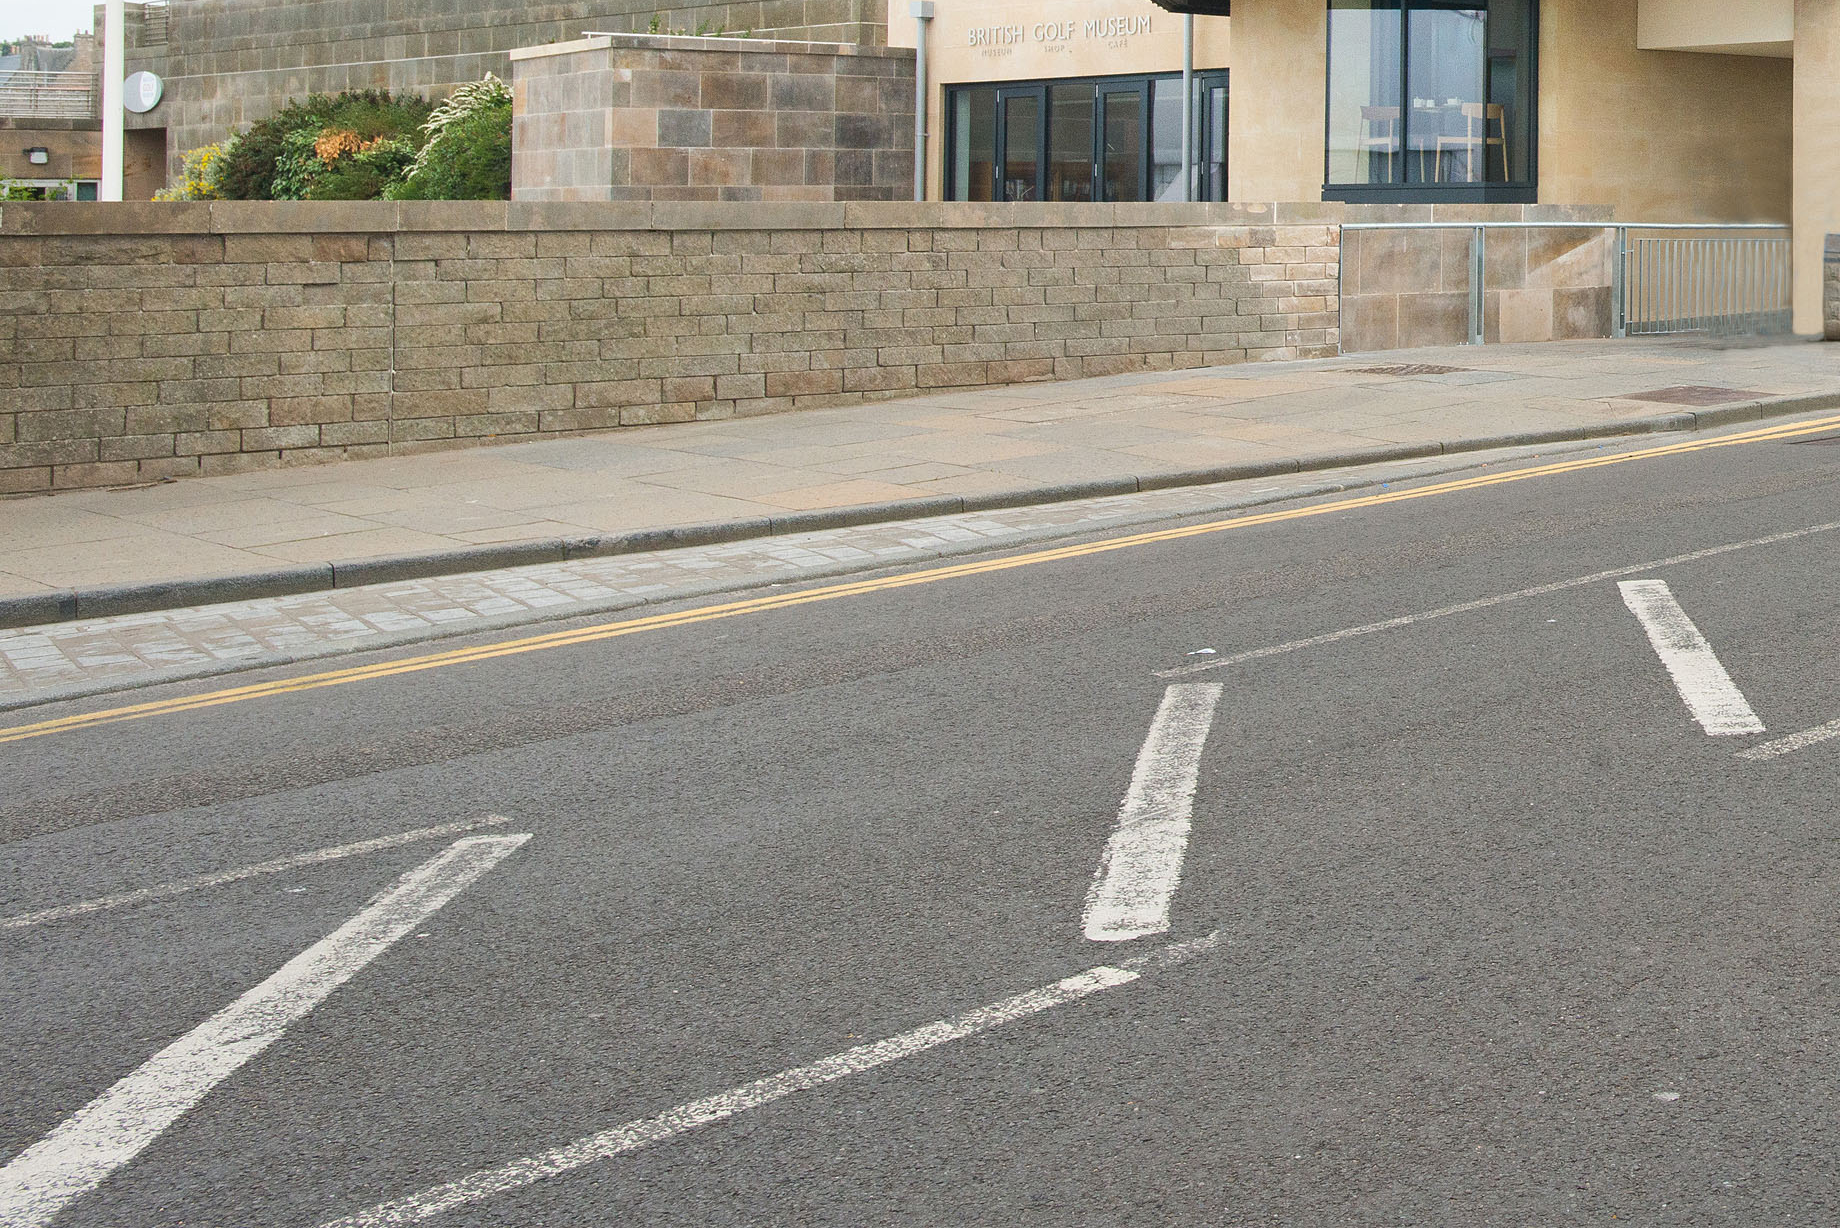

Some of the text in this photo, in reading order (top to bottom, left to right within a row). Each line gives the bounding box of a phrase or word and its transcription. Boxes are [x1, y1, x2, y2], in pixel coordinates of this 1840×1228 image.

[967, 15, 1151, 47] BRITISH GOLF MUSEUM
[981, 48, 1012, 57] MUSEUM
[1044, 45, 1065, 53] SHOP
